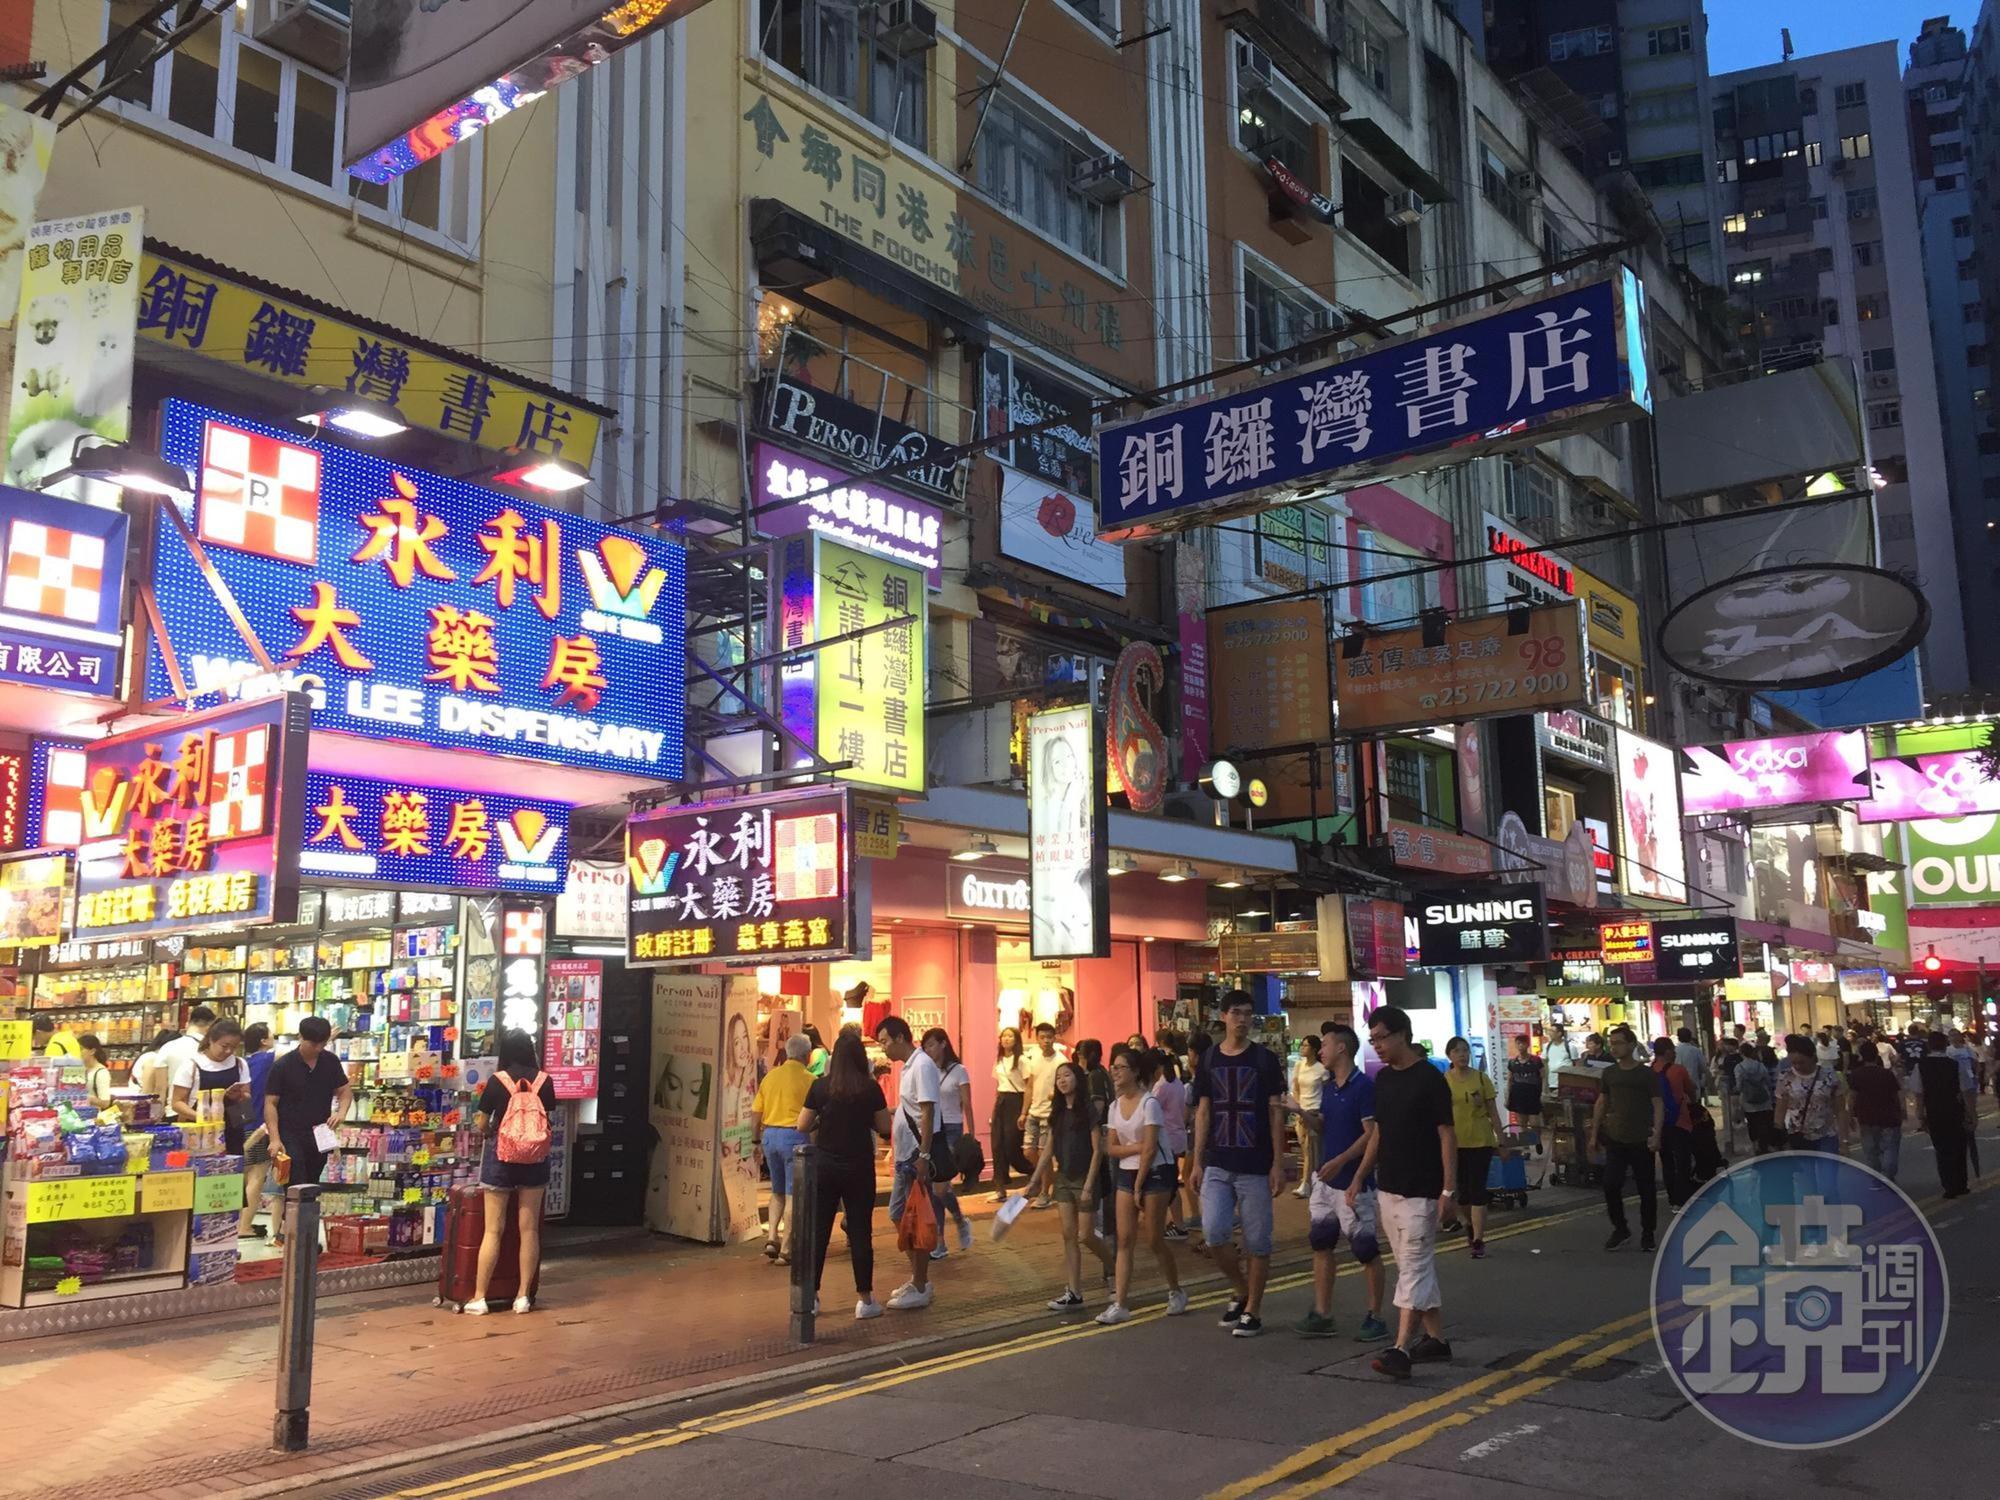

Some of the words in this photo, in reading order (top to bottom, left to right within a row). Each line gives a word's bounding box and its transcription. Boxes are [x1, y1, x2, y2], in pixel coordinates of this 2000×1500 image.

[29, 234, 123, 271] 寵物用品
[62, 258, 133, 285] 專門店
[820, 200, 863, 241] THE
[872, 234, 961, 294] FOOCHOW
[138, 262, 574, 457] 銅鑼灣書店
[1118, 306, 1592, 510] 銅鑼灣書店
[350, 472, 562, 619] 永利
[285, 582, 607, 711] 大藥房
[1284, 629, 1309, 643] 900
[1519, 635, 1567, 672] 98
[0, 642, 102, 685] 有限公司
[838, 600, 866, 771] 請上一樓
[882, 574, 909, 779] 銅鑼灣書店
[1438, 685, 1468, 707] 25
[1472, 679, 1518, 703] 722
[1521, 671, 1569, 695] 900
[348, 681, 427, 728] LEE
[440, 698, 664, 763] DISPENSARY
[1033, 722, 1066, 735] Person
[1068, 720, 1089, 730] Nail
[126, 728, 219, 817] 永利
[120, 812, 211, 879] 大藥房
[310, 786, 492, 861] 大藥房
[681, 807, 772, 876] 永利
[677, 872, 776, 922] 大藥房
[1425, 899, 1534, 926] SUNING
[1660, 931, 1730, 949] SUNING
[656, 983, 693, 998] Person
[696, 984, 719, 1000] Nail
[49, 1203, 63, 1218] 17
[681, 1182, 703, 1198] 2/F
